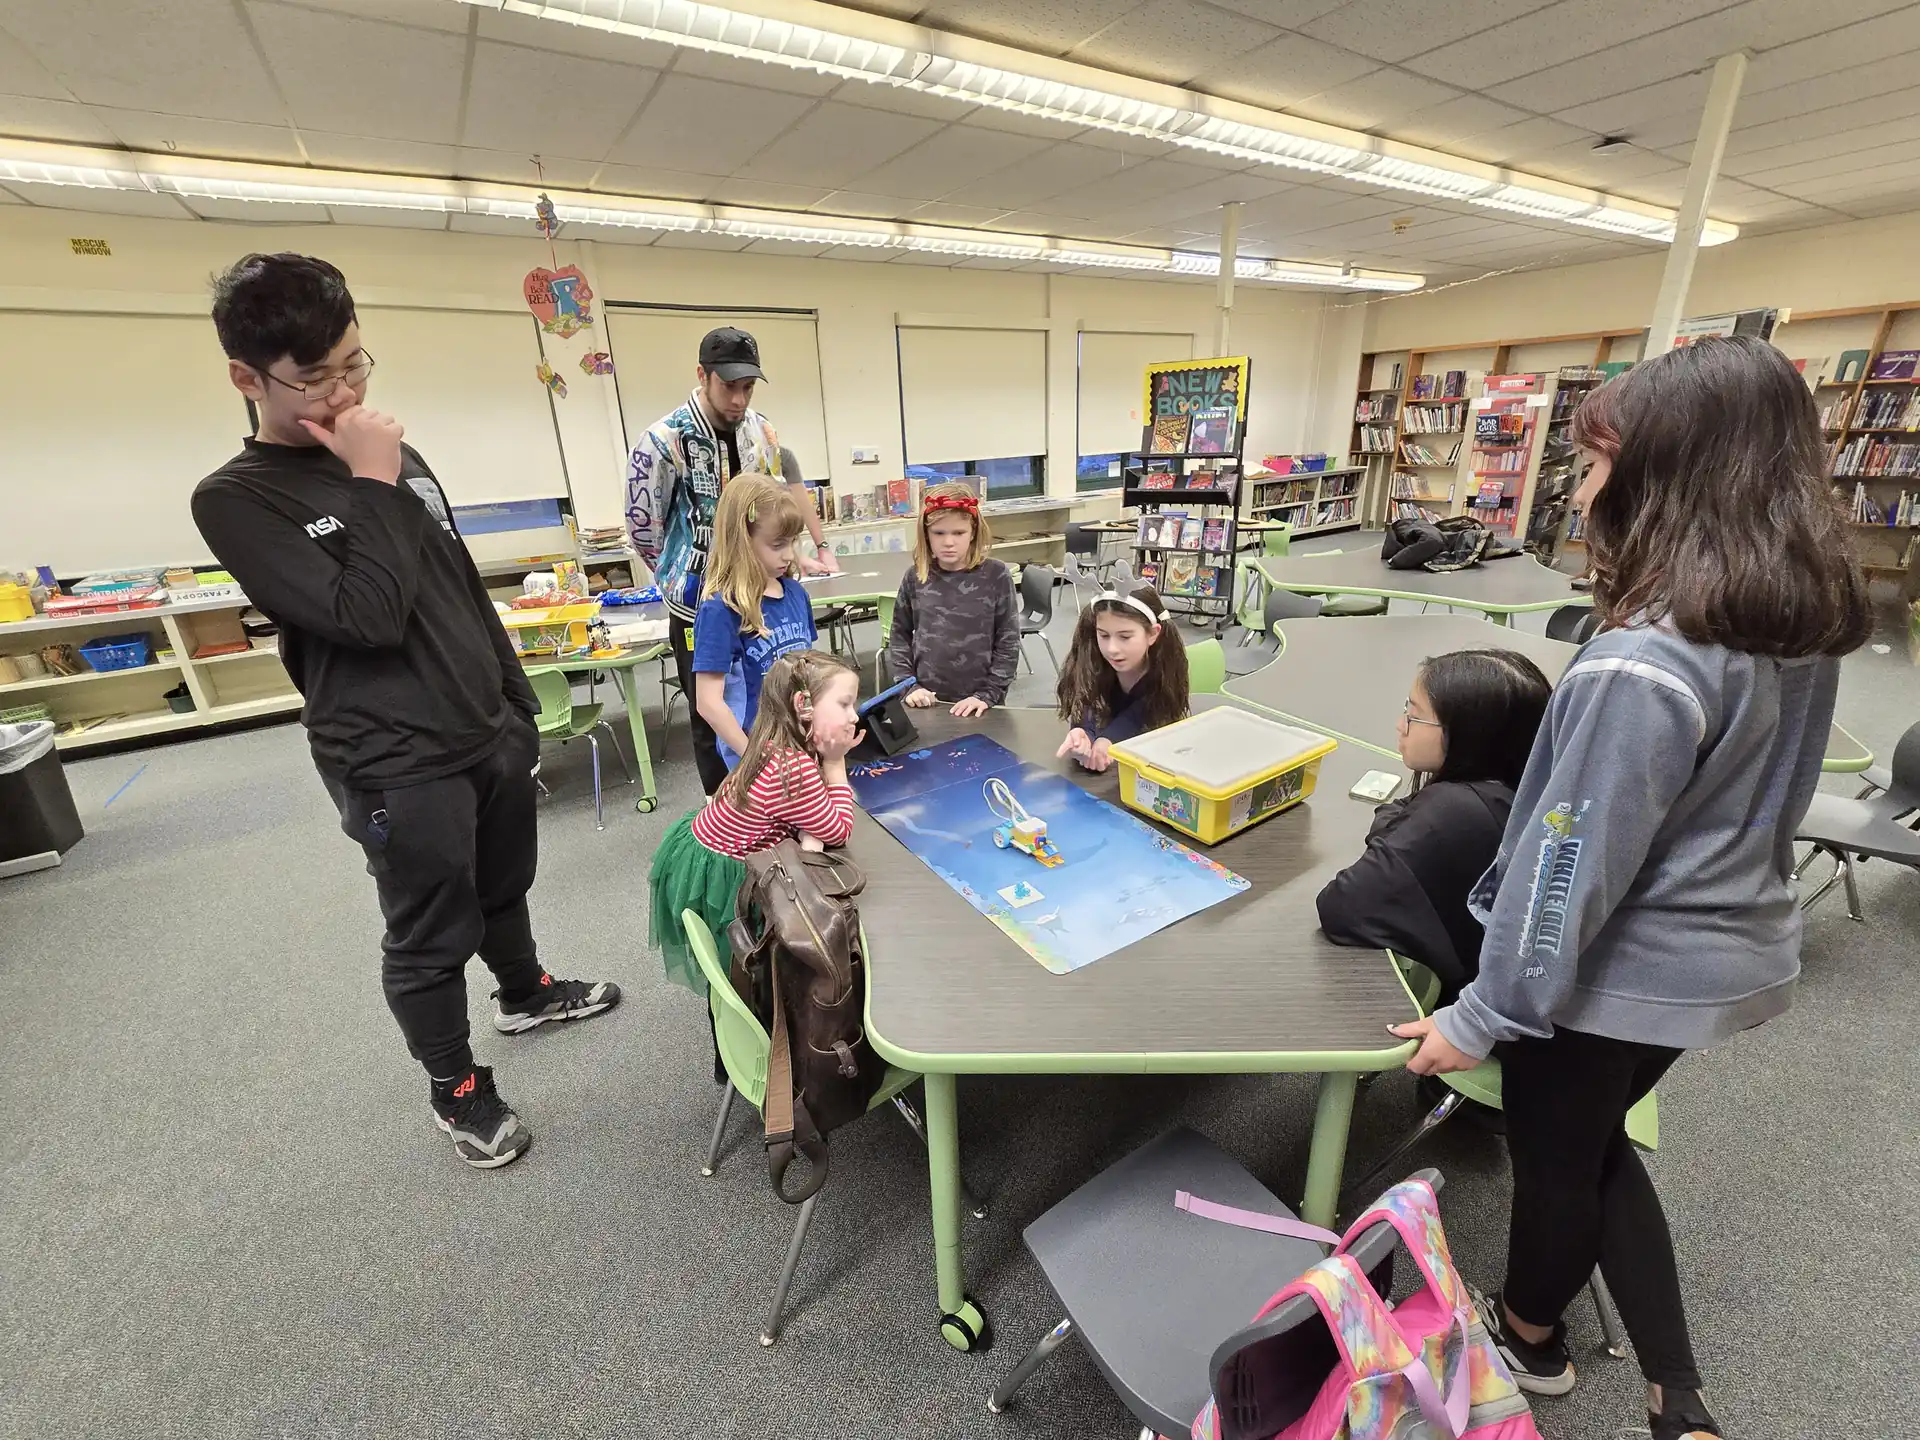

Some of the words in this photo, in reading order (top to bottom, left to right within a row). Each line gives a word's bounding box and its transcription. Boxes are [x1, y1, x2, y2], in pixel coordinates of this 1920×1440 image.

[70, 238, 108, 248] RESCUE
[72, 246, 112, 256] WINDOW
[528, 293, 559, 304] READ
[1167, 371, 1223, 396] NEW
[1157, 393, 1236, 415] BOOKS
[1543, 840, 1581, 910] WHITE
[1535, 907, 1566, 954] OUT
